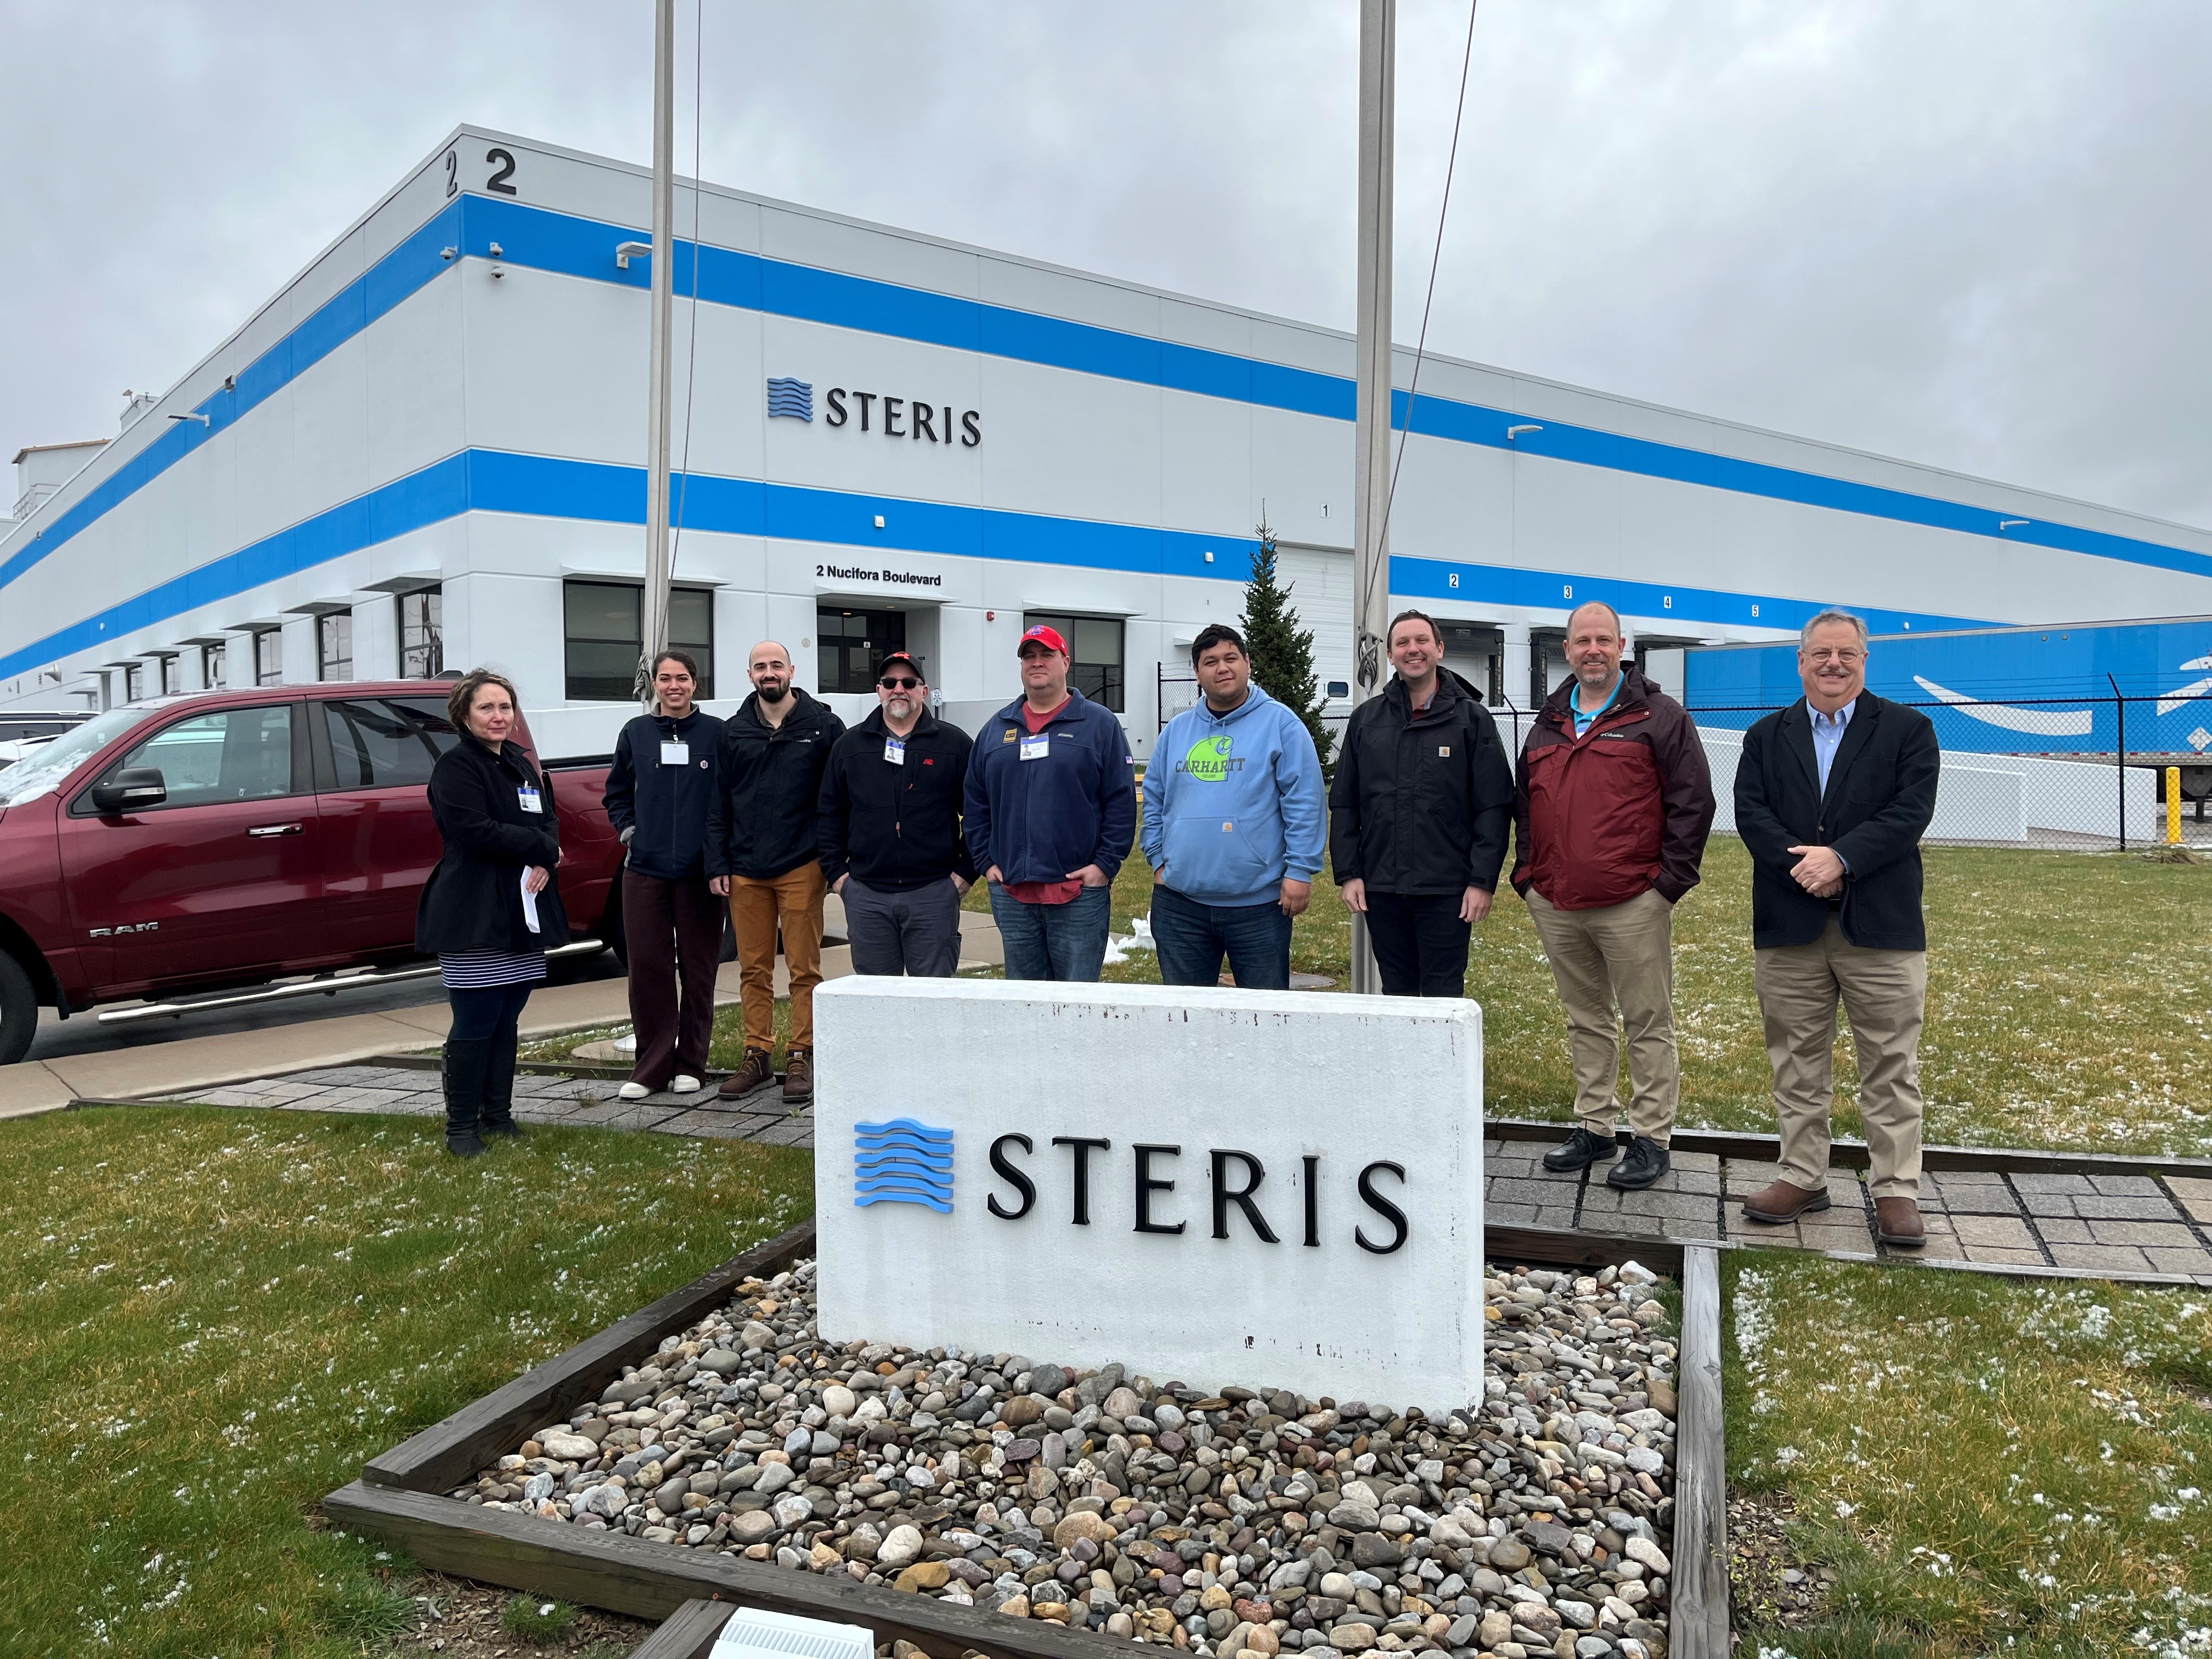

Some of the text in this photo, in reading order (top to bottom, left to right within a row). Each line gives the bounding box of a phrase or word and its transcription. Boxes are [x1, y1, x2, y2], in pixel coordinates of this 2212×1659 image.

[446, 150, 457, 197] 2
[487, 148, 516, 195] 2
[826, 388, 981, 447] STERIS
[1323, 505, 1328, 517] 1
[816, 565, 941, 585] 2 Nucifora Boulevard
[1451, 575, 1457, 586] 2
[1565, 587, 1570, 597] 3
[1665, 597, 1670, 608] 4
[1753, 606, 1757, 616] 5
[1176, 758, 1246, 773] CARHARTT
[89, 922, 159, 937] RAM
[988, 1132, 1408, 1254] STERIS
